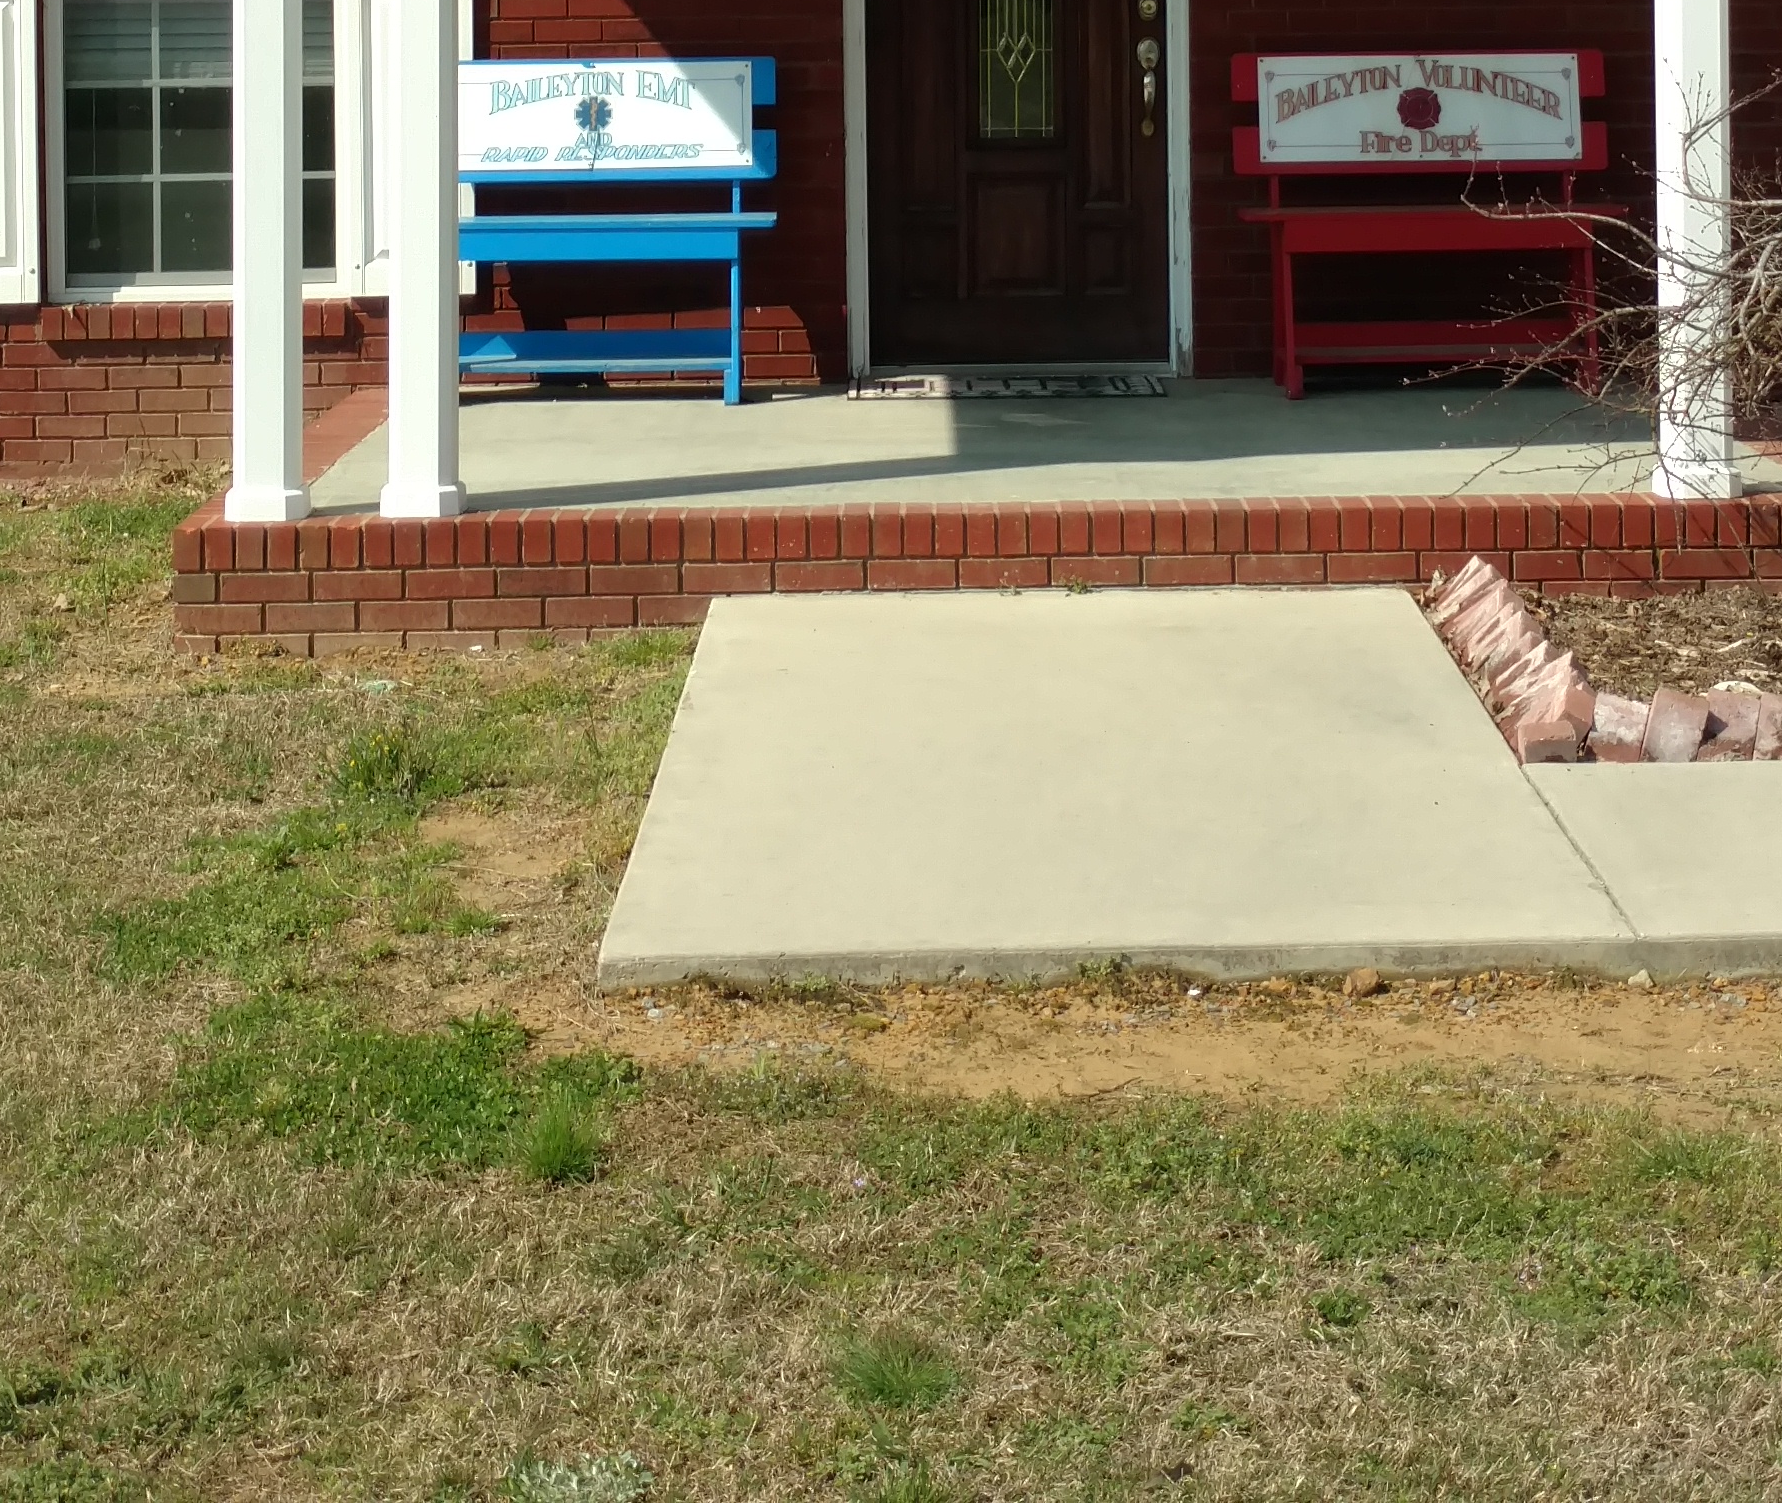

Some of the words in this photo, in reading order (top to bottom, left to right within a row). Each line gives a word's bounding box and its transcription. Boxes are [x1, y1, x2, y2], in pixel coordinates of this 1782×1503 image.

[489, 71, 625, 115] BAILEYTON
[635, 69, 696, 110] EMT
[1275, 64, 1402, 124] BAILEYTON
[1414, 59, 1564, 121] VOLUNTEER
[574, 132, 613, 147] AND
[1359, 130, 1413, 154] Fire
[481, 146, 549, 163] RAPID
[554, 143, 704, 162] RESPONDERS
